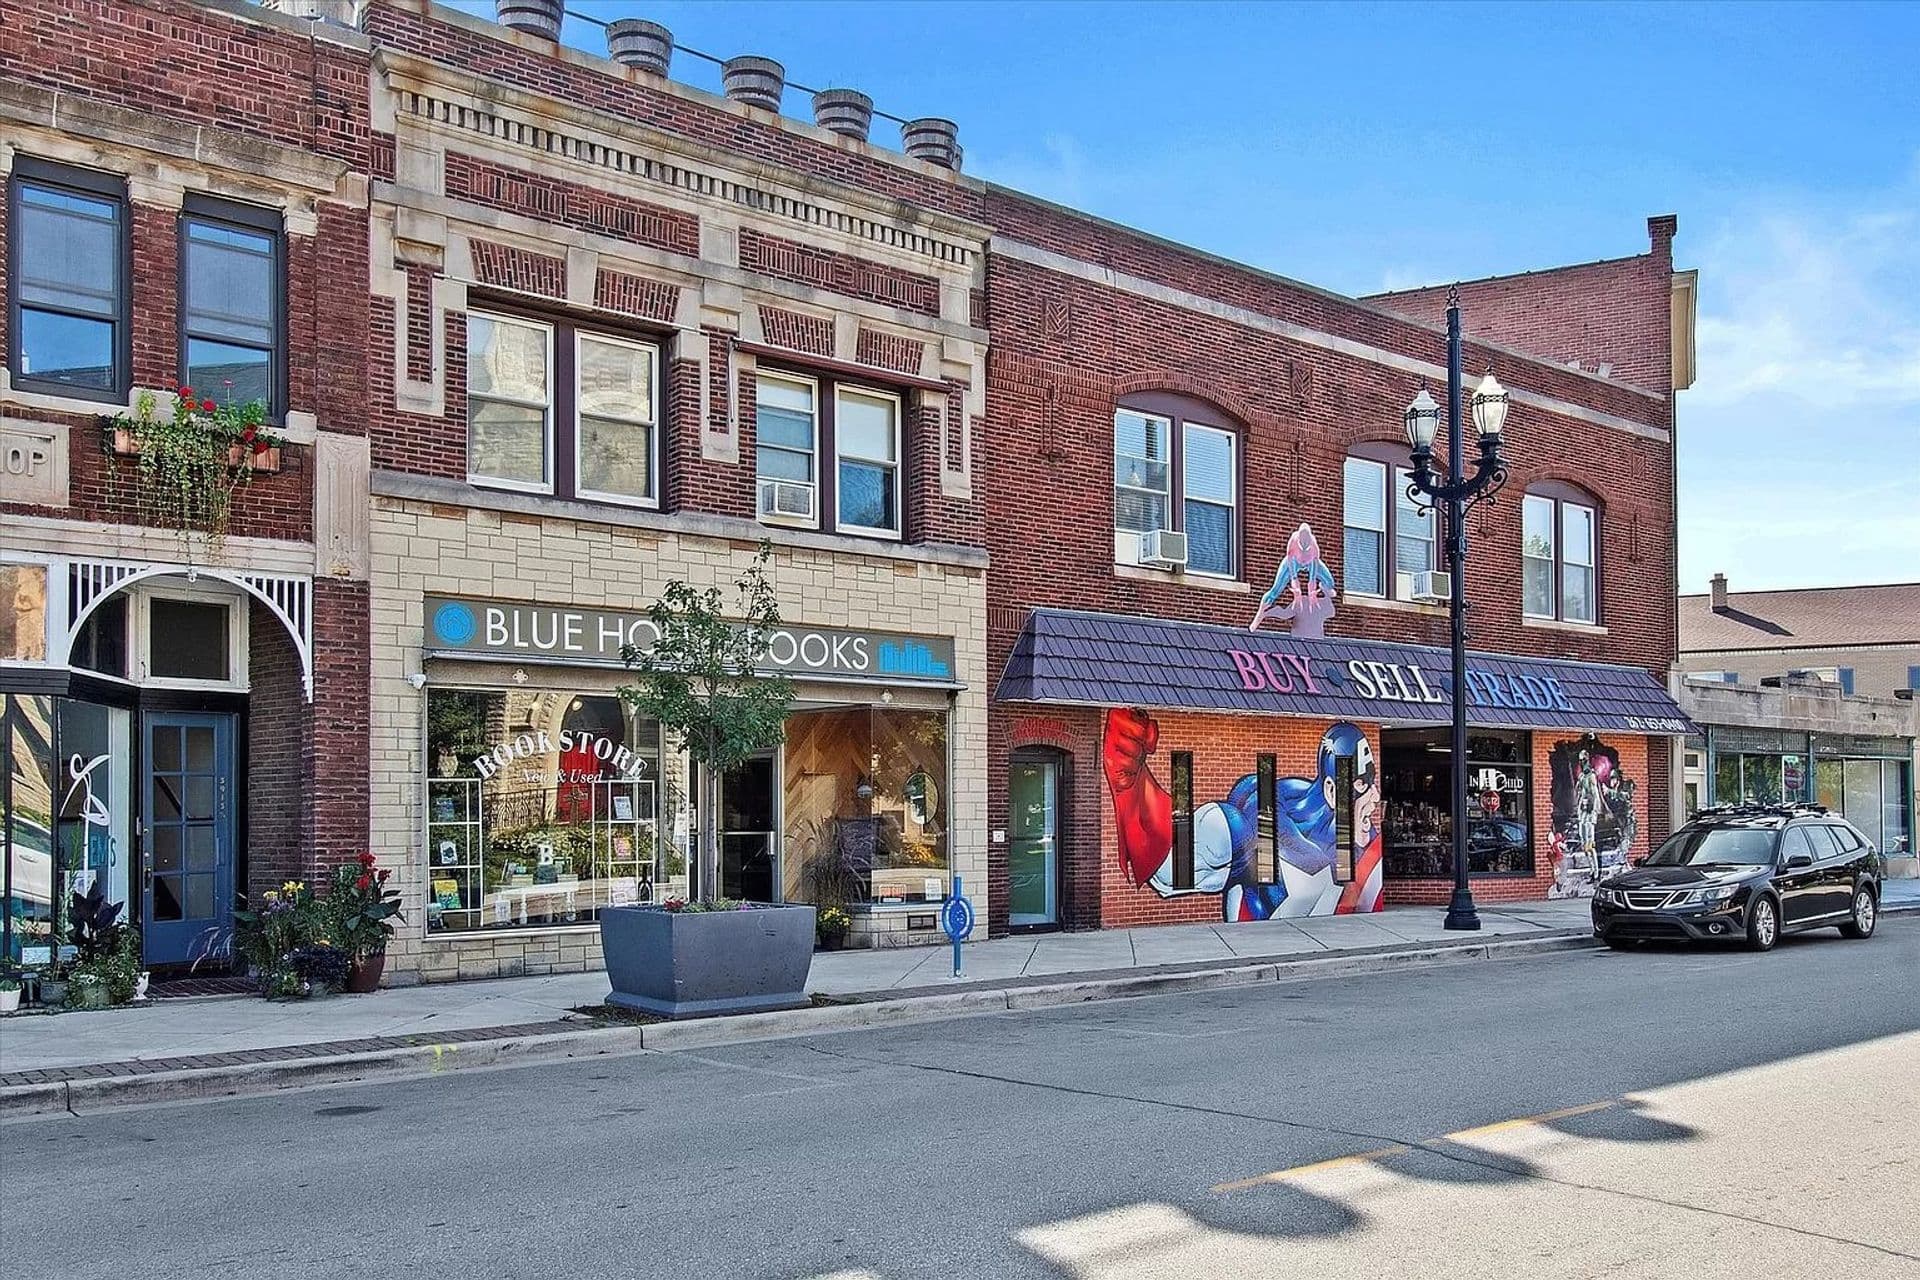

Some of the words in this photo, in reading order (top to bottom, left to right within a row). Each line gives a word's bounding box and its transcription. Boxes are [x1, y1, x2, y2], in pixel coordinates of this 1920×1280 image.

[0, 446, 49, 477] OP
[485, 607, 584, 651] BLUE
[1226, 649, 1321, 695] BUY
[1349, 659, 1443, 703] SELL
[1464, 669, 1574, 712] TRADE
[472, 729, 649, 781] BOOKSTORE
[523, 768, 550, 783] New
[556, 768, 567, 783] &
[570, 769, 604, 783] Used
